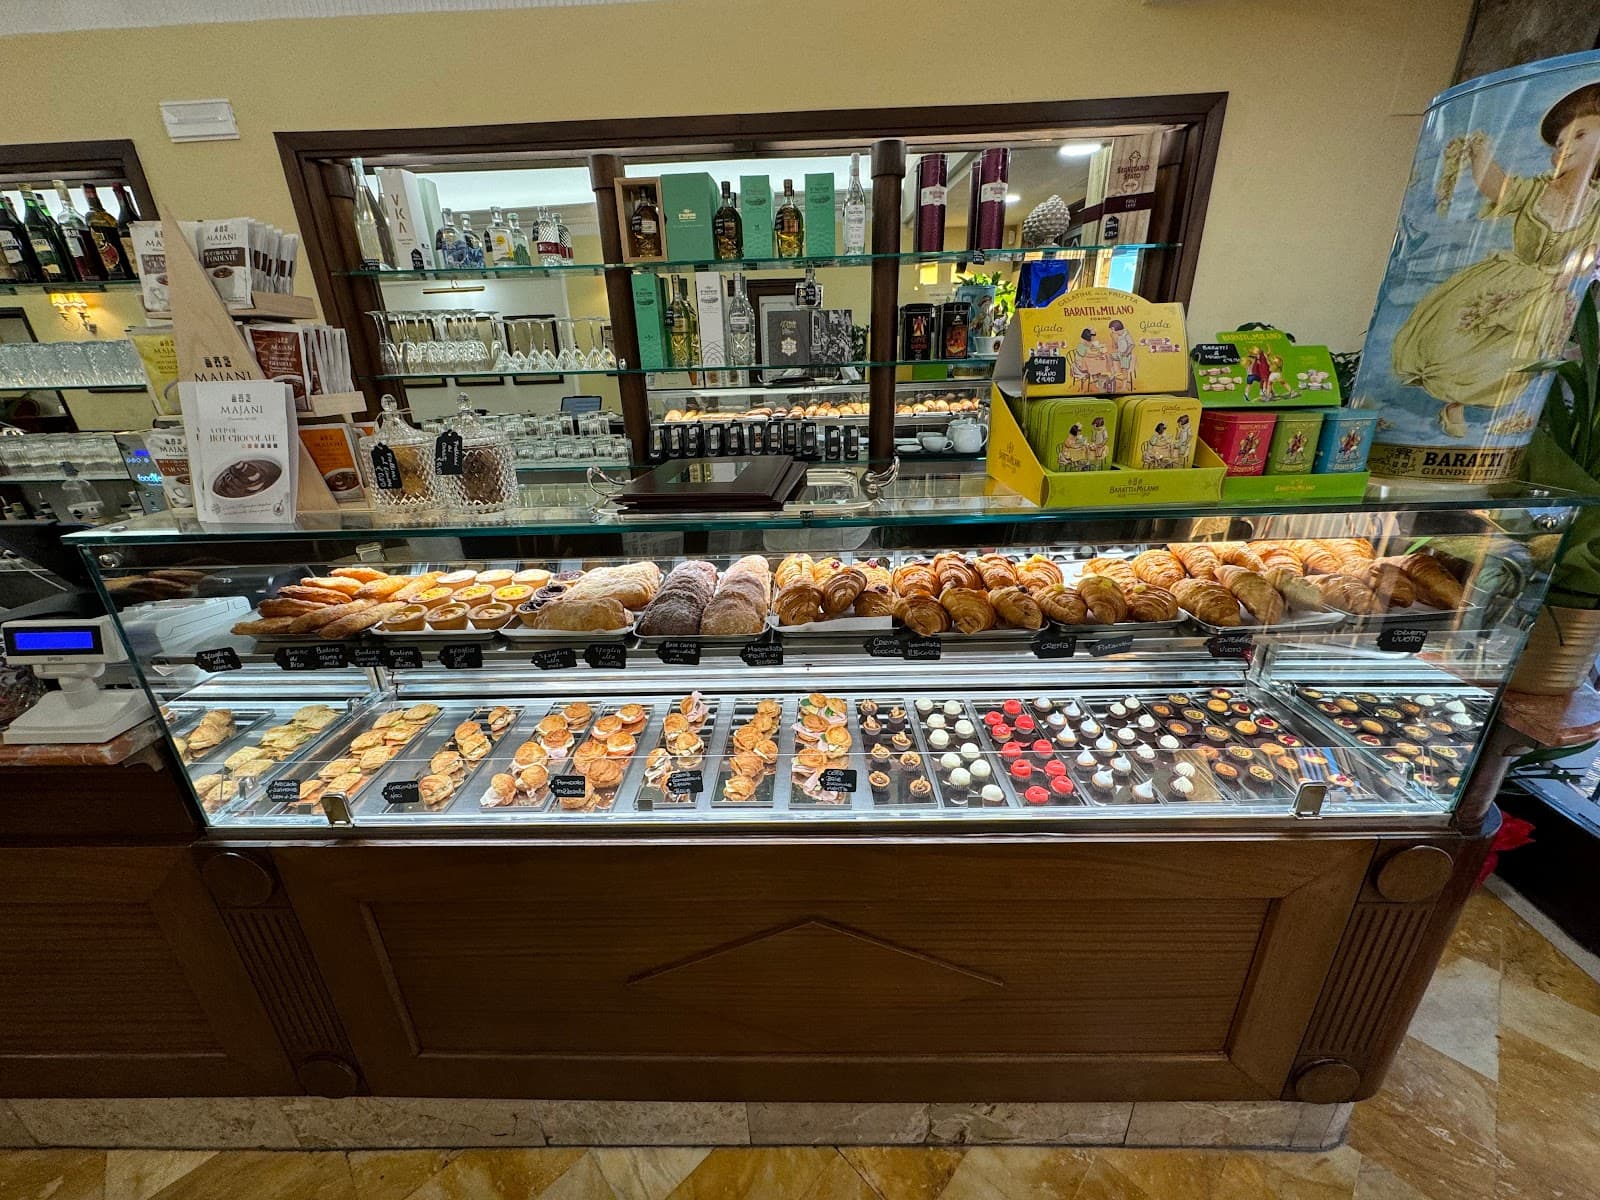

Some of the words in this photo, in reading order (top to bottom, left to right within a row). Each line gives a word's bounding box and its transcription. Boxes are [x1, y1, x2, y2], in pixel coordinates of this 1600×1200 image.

[1063, 306, 1096, 317] BARATTI
[1101, 305, 1134, 316] MILANO
[194, 371, 251, 382] MAJANI
[220, 405, 263, 416] MAJANI
[1423, 452, 1504, 467] BARATTI
